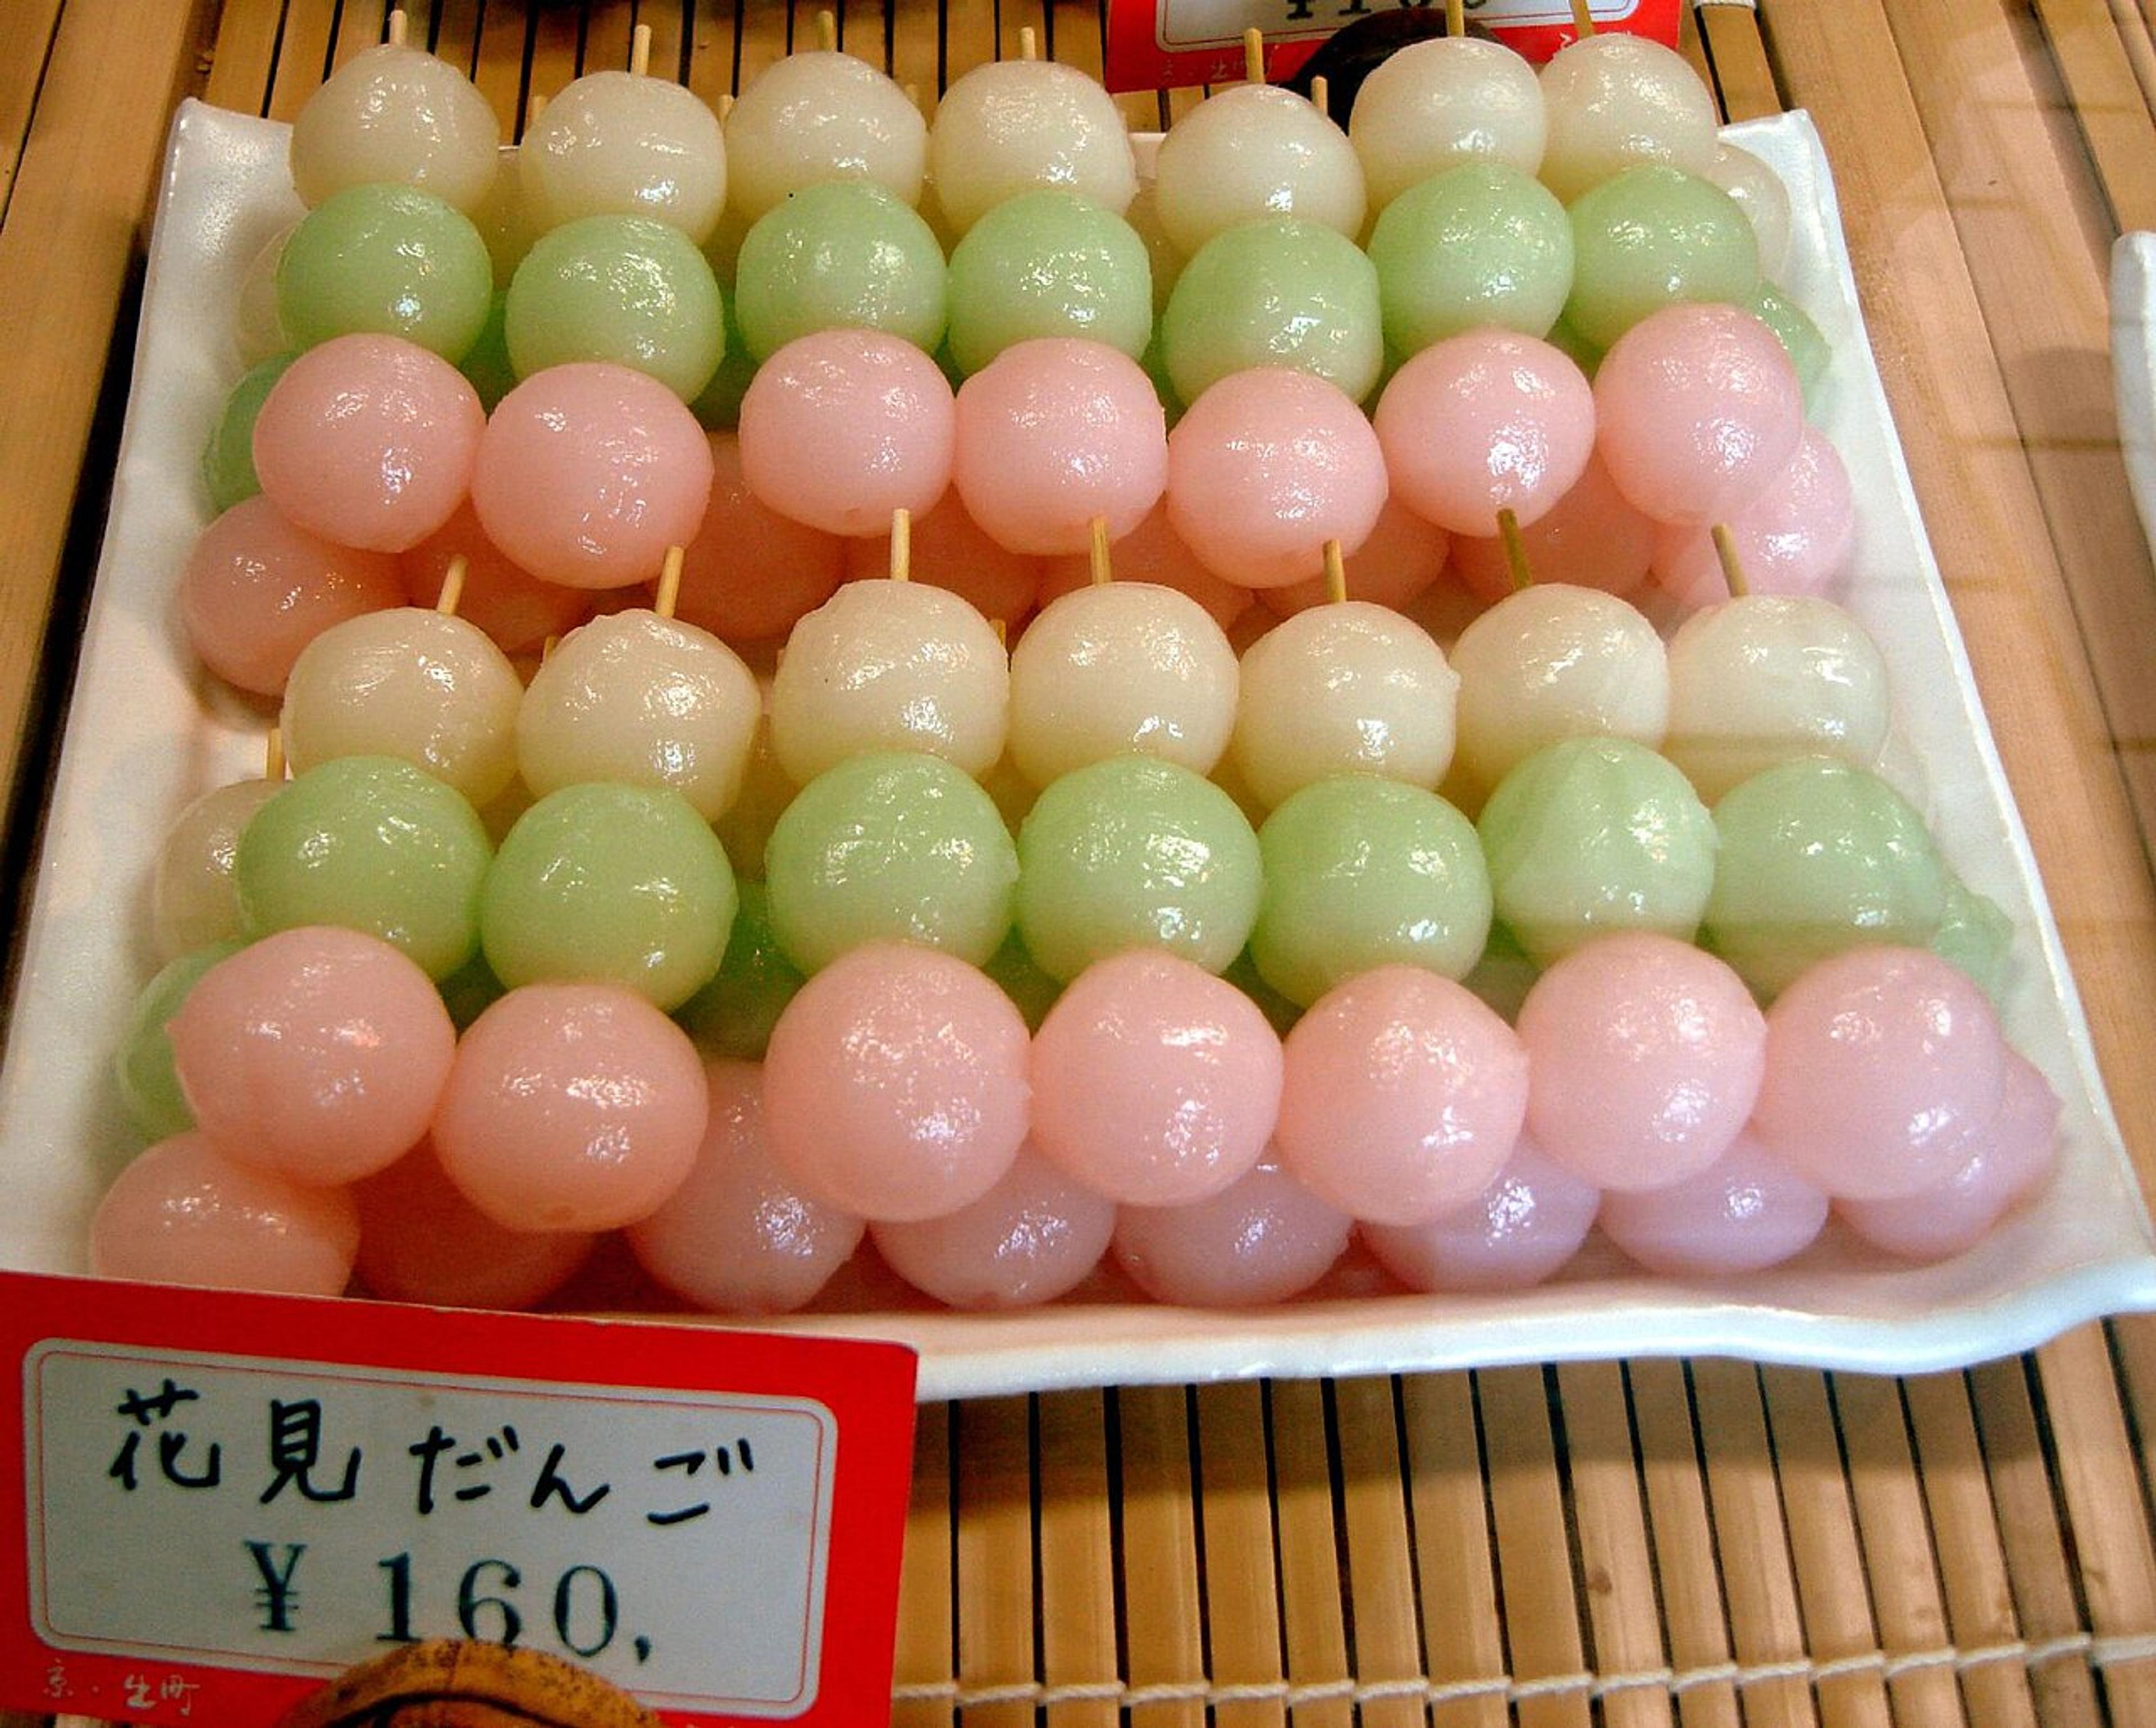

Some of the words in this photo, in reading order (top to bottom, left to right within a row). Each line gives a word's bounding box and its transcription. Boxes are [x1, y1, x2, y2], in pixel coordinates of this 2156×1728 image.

[109, 1378, 755, 1525] 花見だんご
